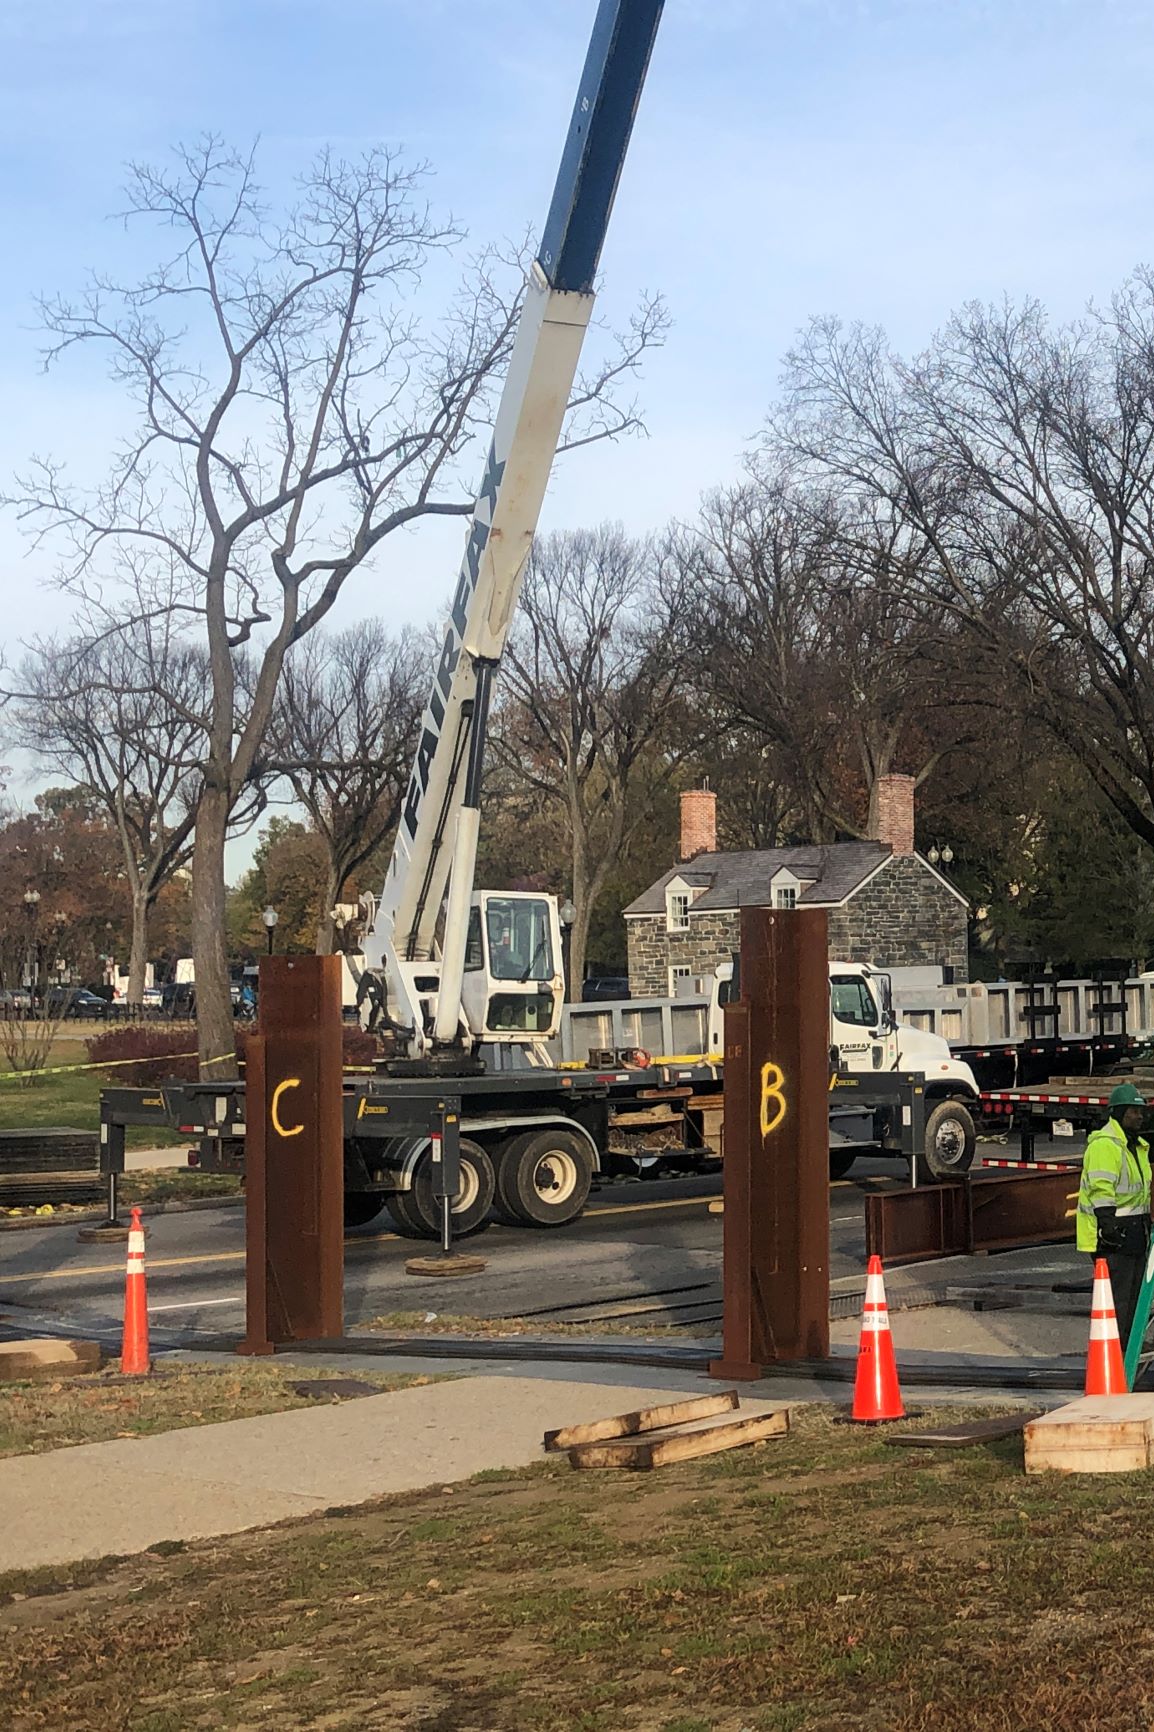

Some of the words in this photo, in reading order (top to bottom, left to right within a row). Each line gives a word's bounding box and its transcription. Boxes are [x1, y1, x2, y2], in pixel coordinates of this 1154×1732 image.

[403, 438, 507, 841] FAIRFAX
[839, 1042, 872, 1051] FAIRFAX
[272, 1079, 304, 1137] C
[760, 1061, 787, 1138] B
